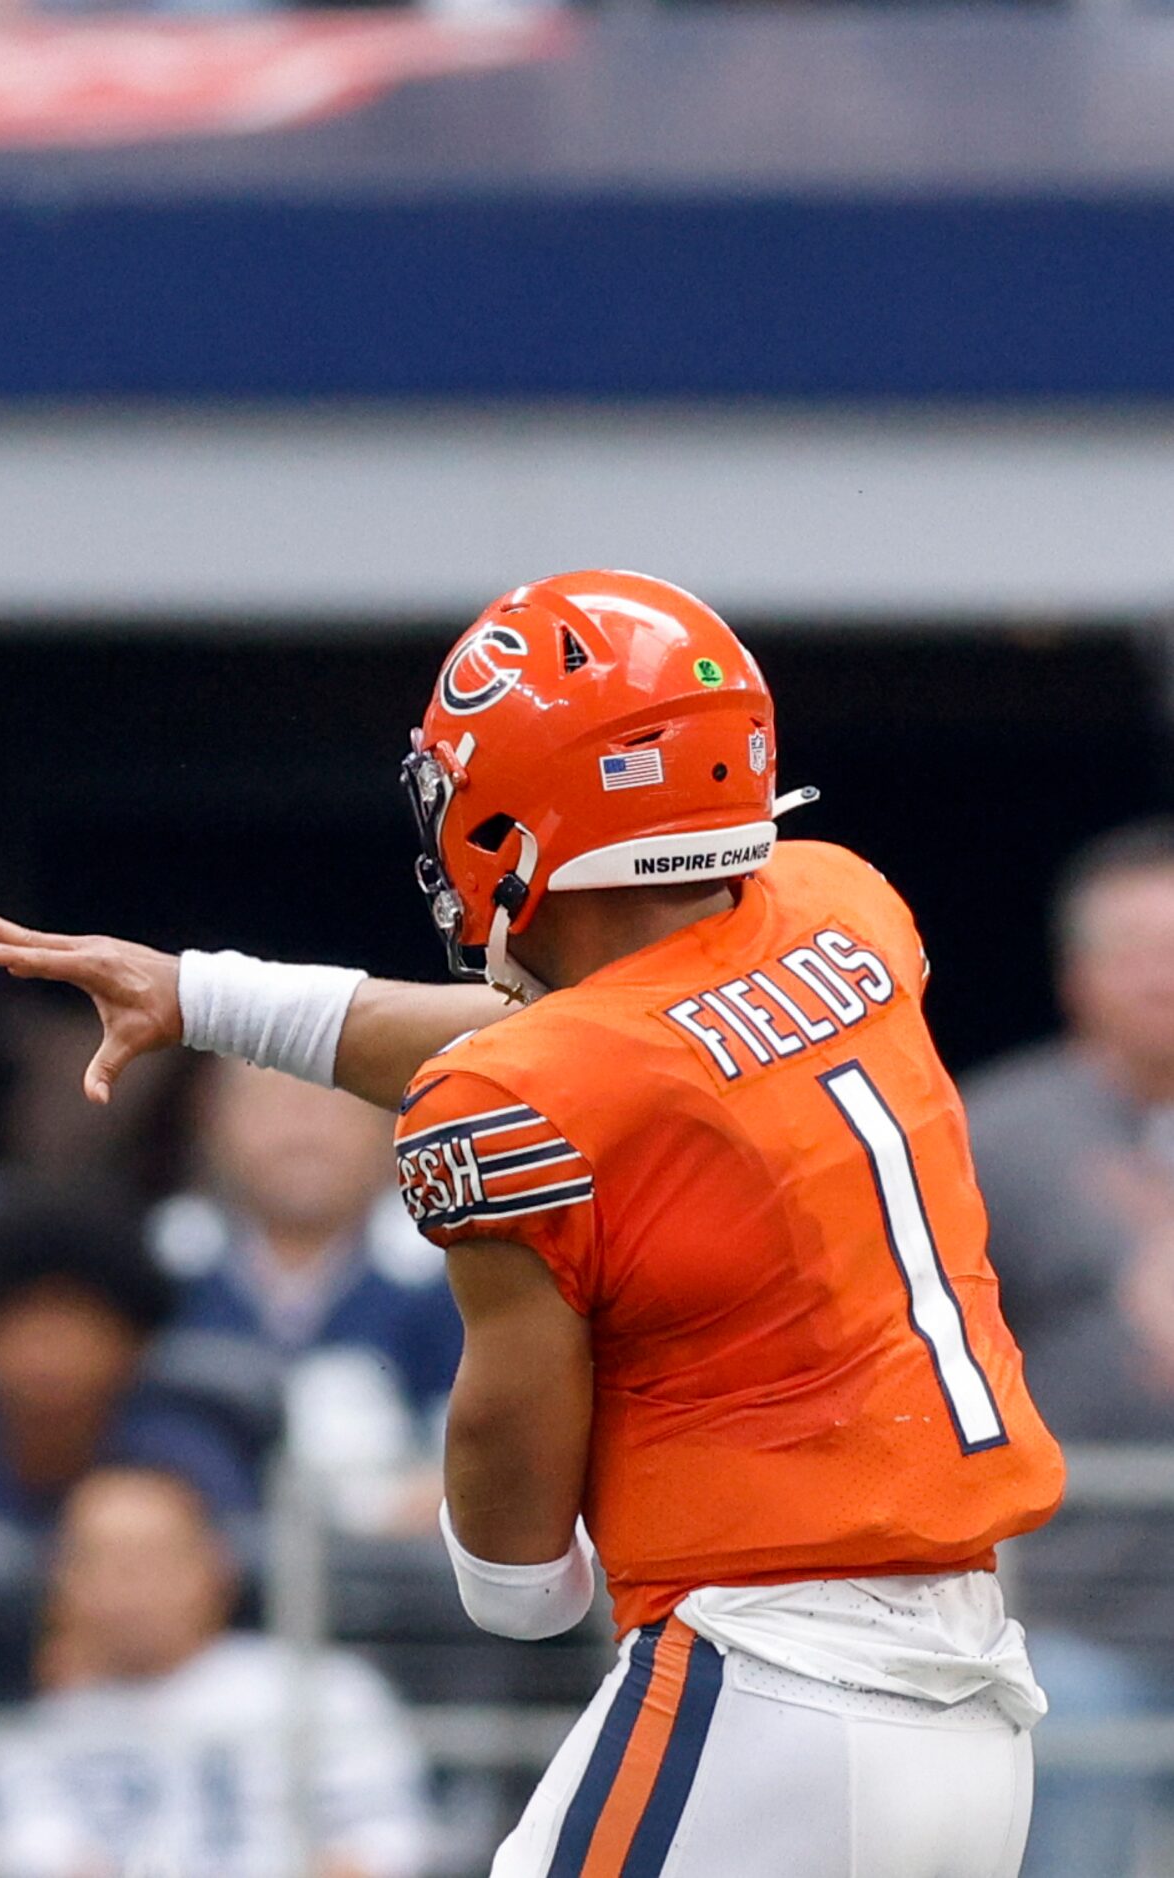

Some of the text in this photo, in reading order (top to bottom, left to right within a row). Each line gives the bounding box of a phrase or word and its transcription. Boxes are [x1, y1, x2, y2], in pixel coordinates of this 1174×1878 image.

[634, 842, 771, 875] INSPIRE CHANGE
[663, 928, 895, 1081] FIELDS
[815, 1057, 1011, 1456] 1
